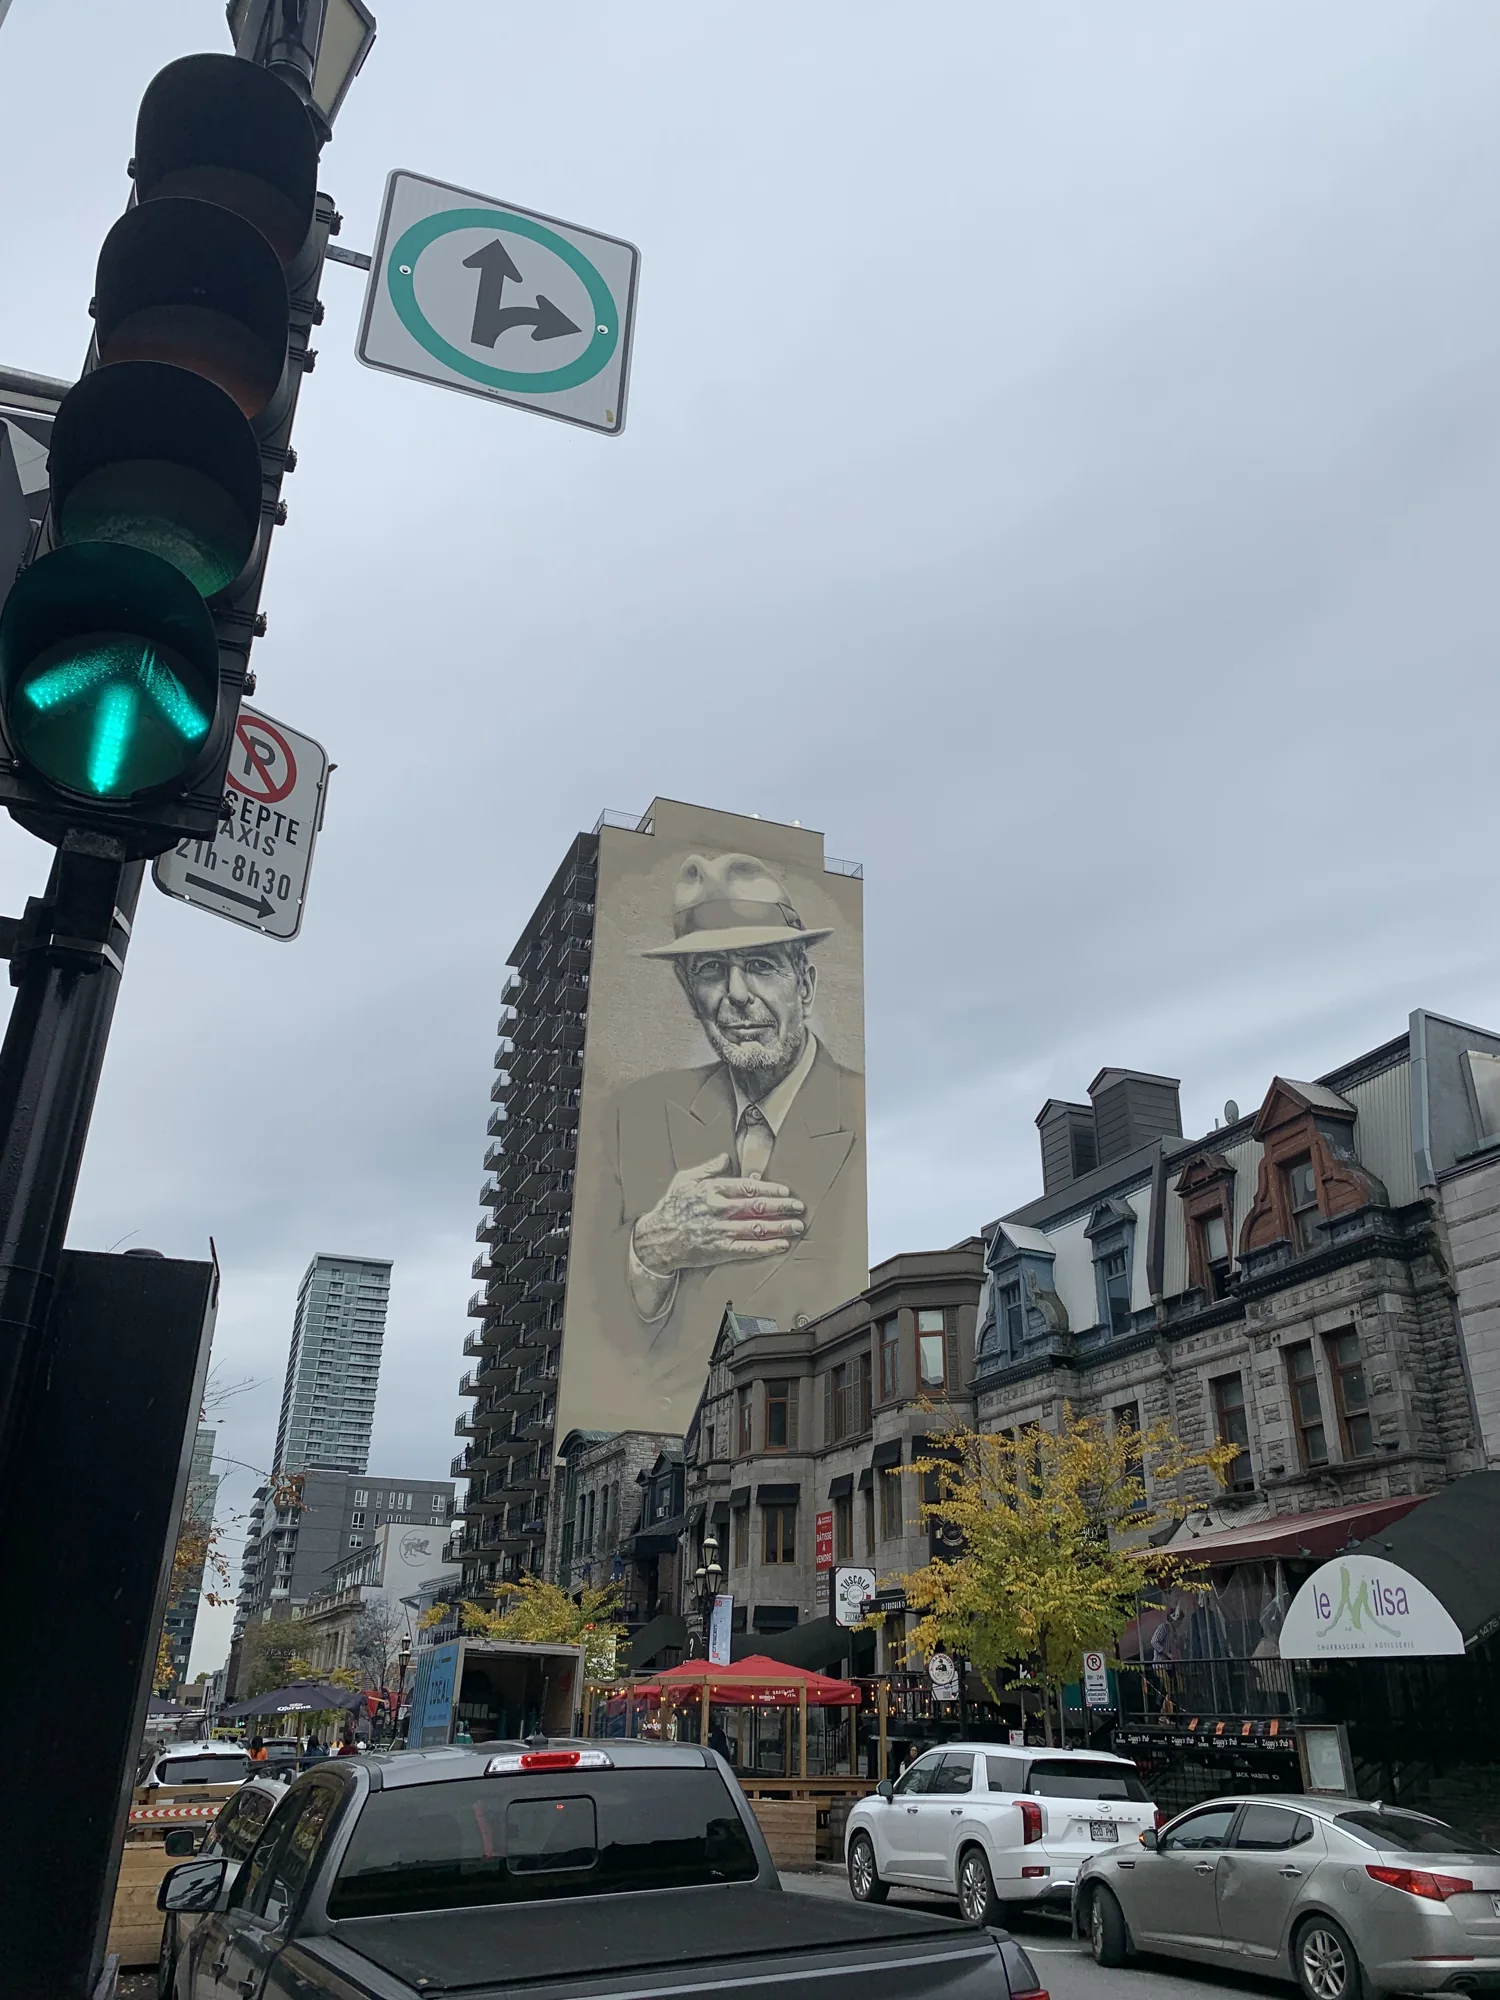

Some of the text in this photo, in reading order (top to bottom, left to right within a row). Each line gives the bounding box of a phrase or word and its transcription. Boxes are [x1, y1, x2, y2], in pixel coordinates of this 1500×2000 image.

[219, 820, 277, 857] AXIS
[816, 1553, 832, 1563] VENDRE
[840, 1575, 870, 1591] TUSCOLO
[1479, 1618, 1499, 1636] 1476
[1317, 1642, 1365, 1651] CHURRASCARIA
